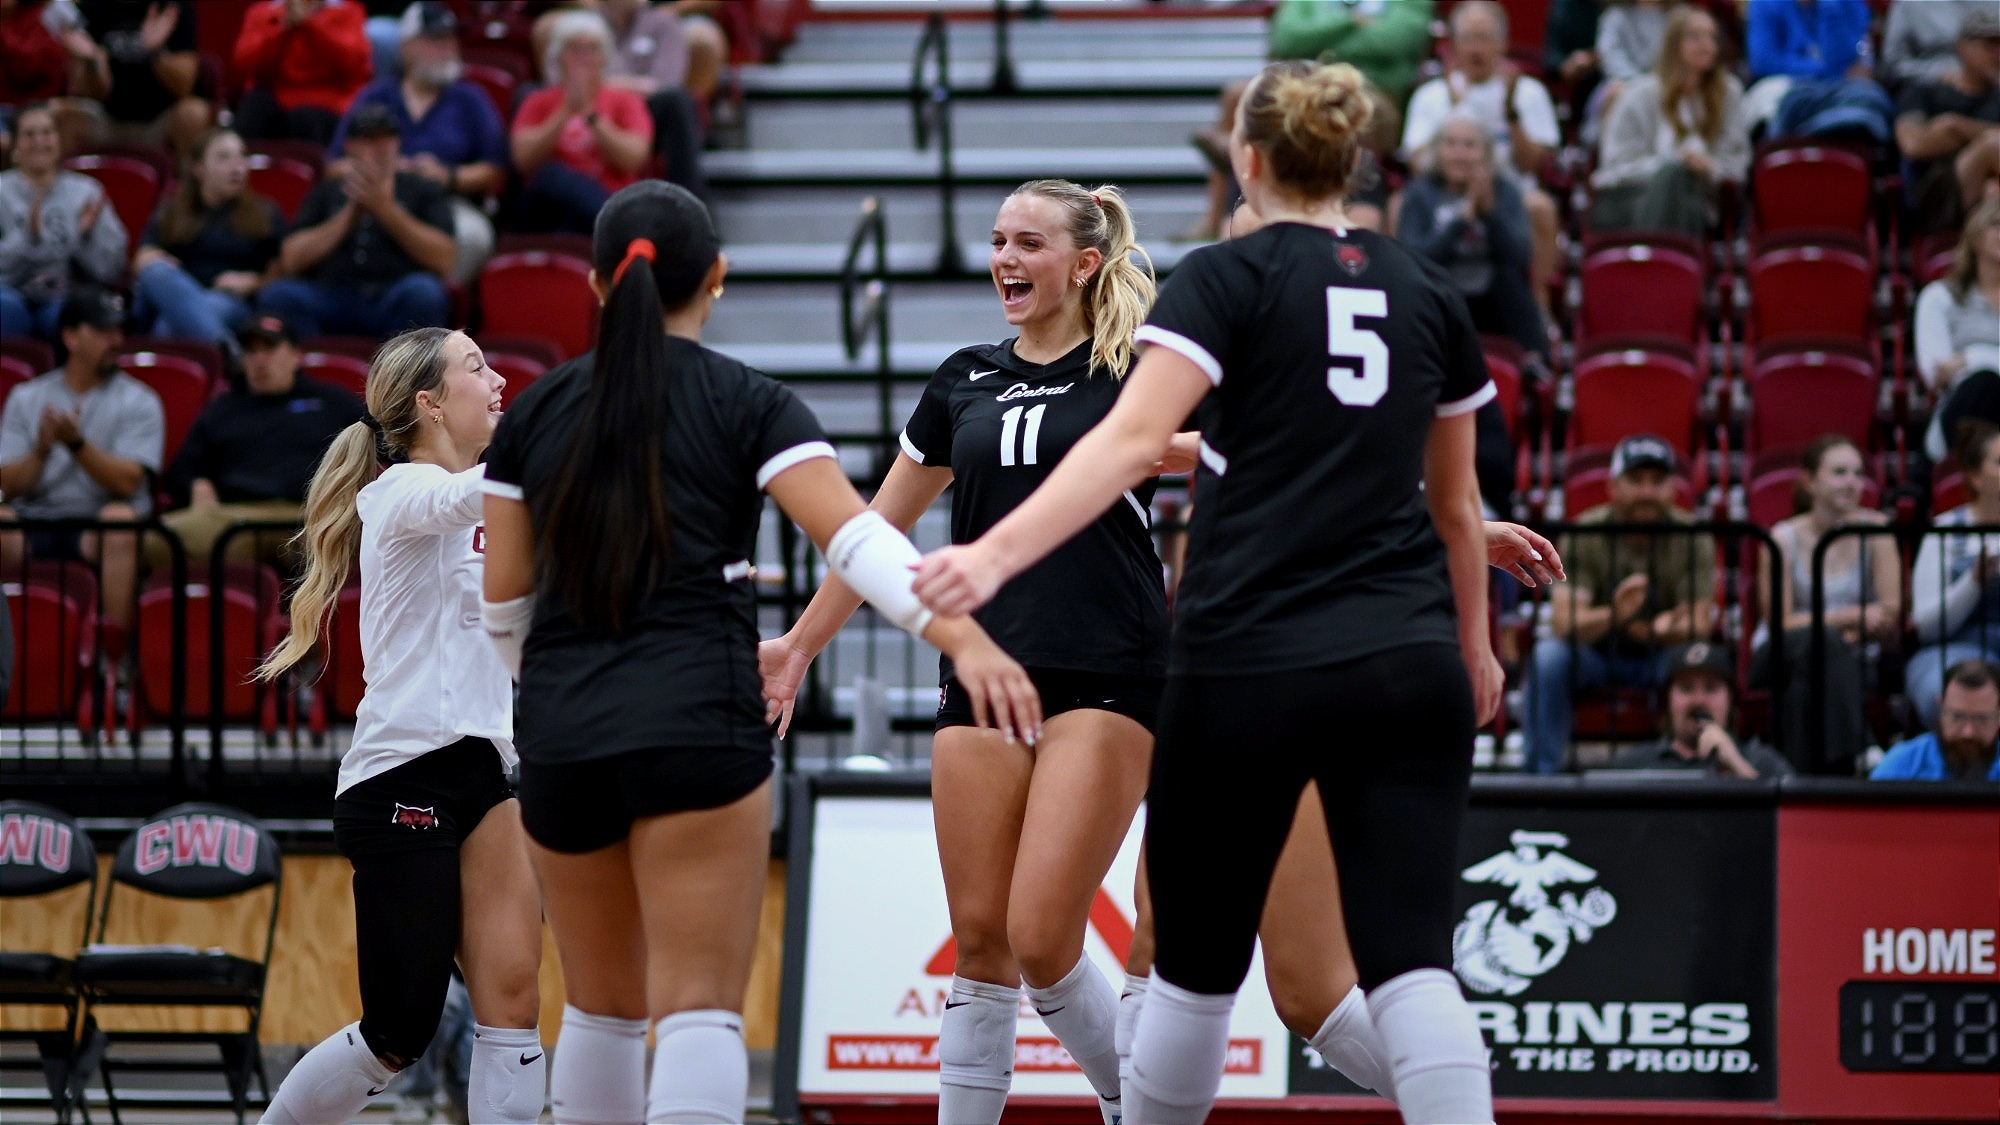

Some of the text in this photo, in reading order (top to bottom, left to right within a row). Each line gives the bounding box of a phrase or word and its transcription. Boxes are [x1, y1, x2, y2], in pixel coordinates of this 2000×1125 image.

[1327, 286, 1389, 406] 5
[996, 382, 1075, 401] Central
[1001, 404, 1046, 466] 11
[0, 814, 72, 874] WU
[136, 815, 258, 875] CWU
[1863, 927, 1996, 974] HOME
[1467, 1002, 1751, 1045] RINES
[1510, 1048, 1595, 1072] THE
